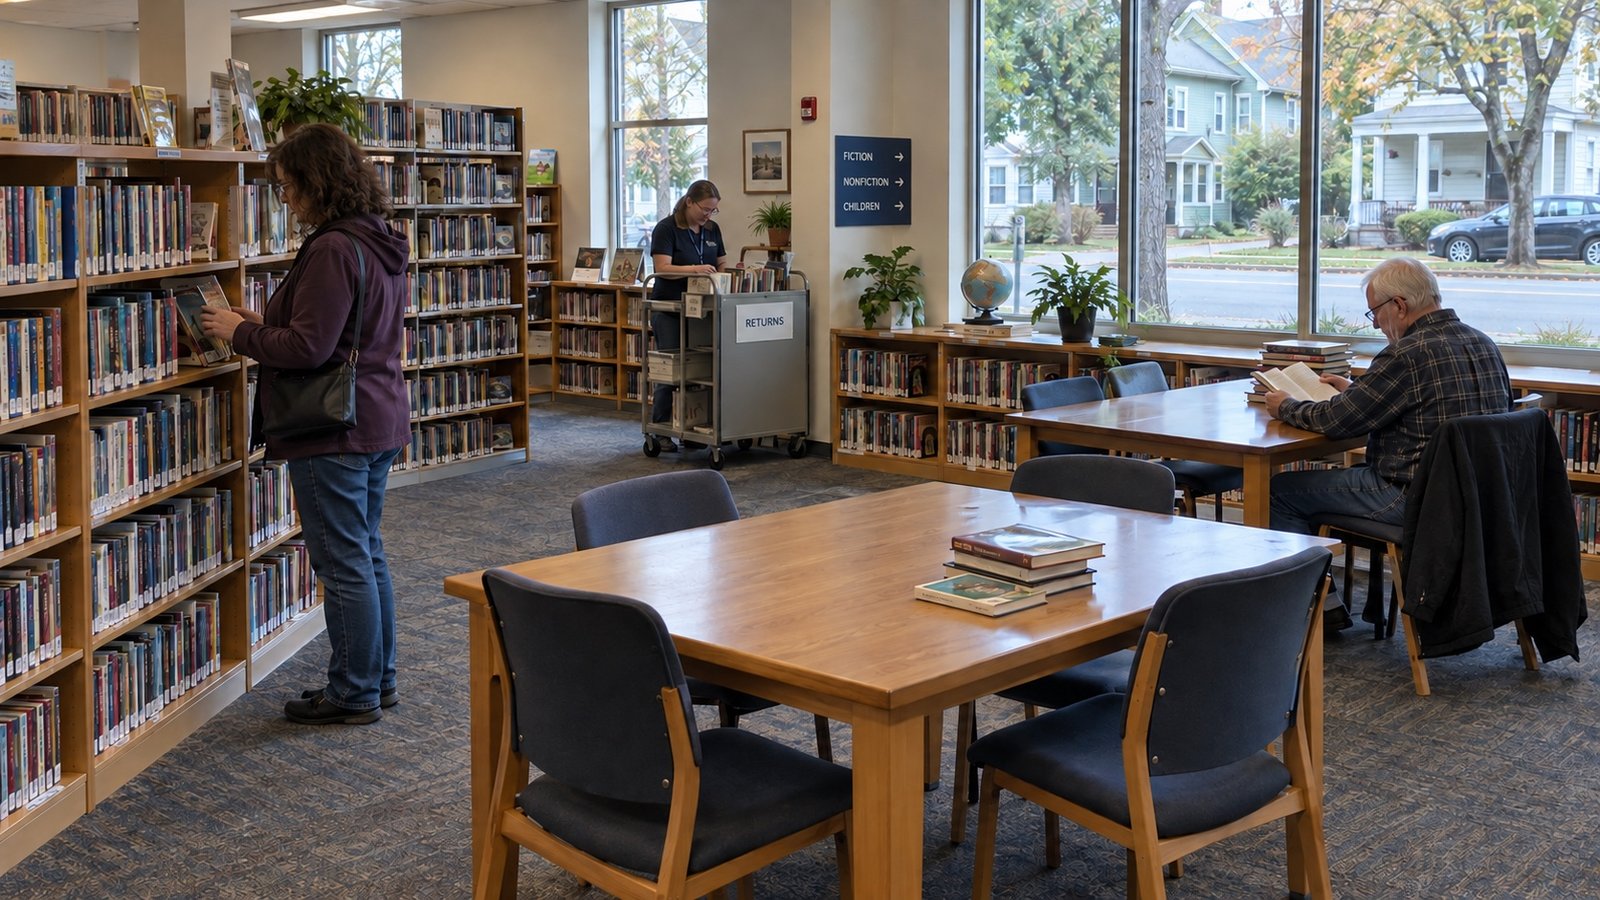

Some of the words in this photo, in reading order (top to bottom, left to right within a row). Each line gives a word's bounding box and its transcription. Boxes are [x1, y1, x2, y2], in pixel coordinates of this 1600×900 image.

[843, 151, 873, 161] FICTION
[843, 177, 889, 187] NONFICTION
[843, 202, 880, 211] CHILDREN
[745, 316, 785, 328] RETURNS
